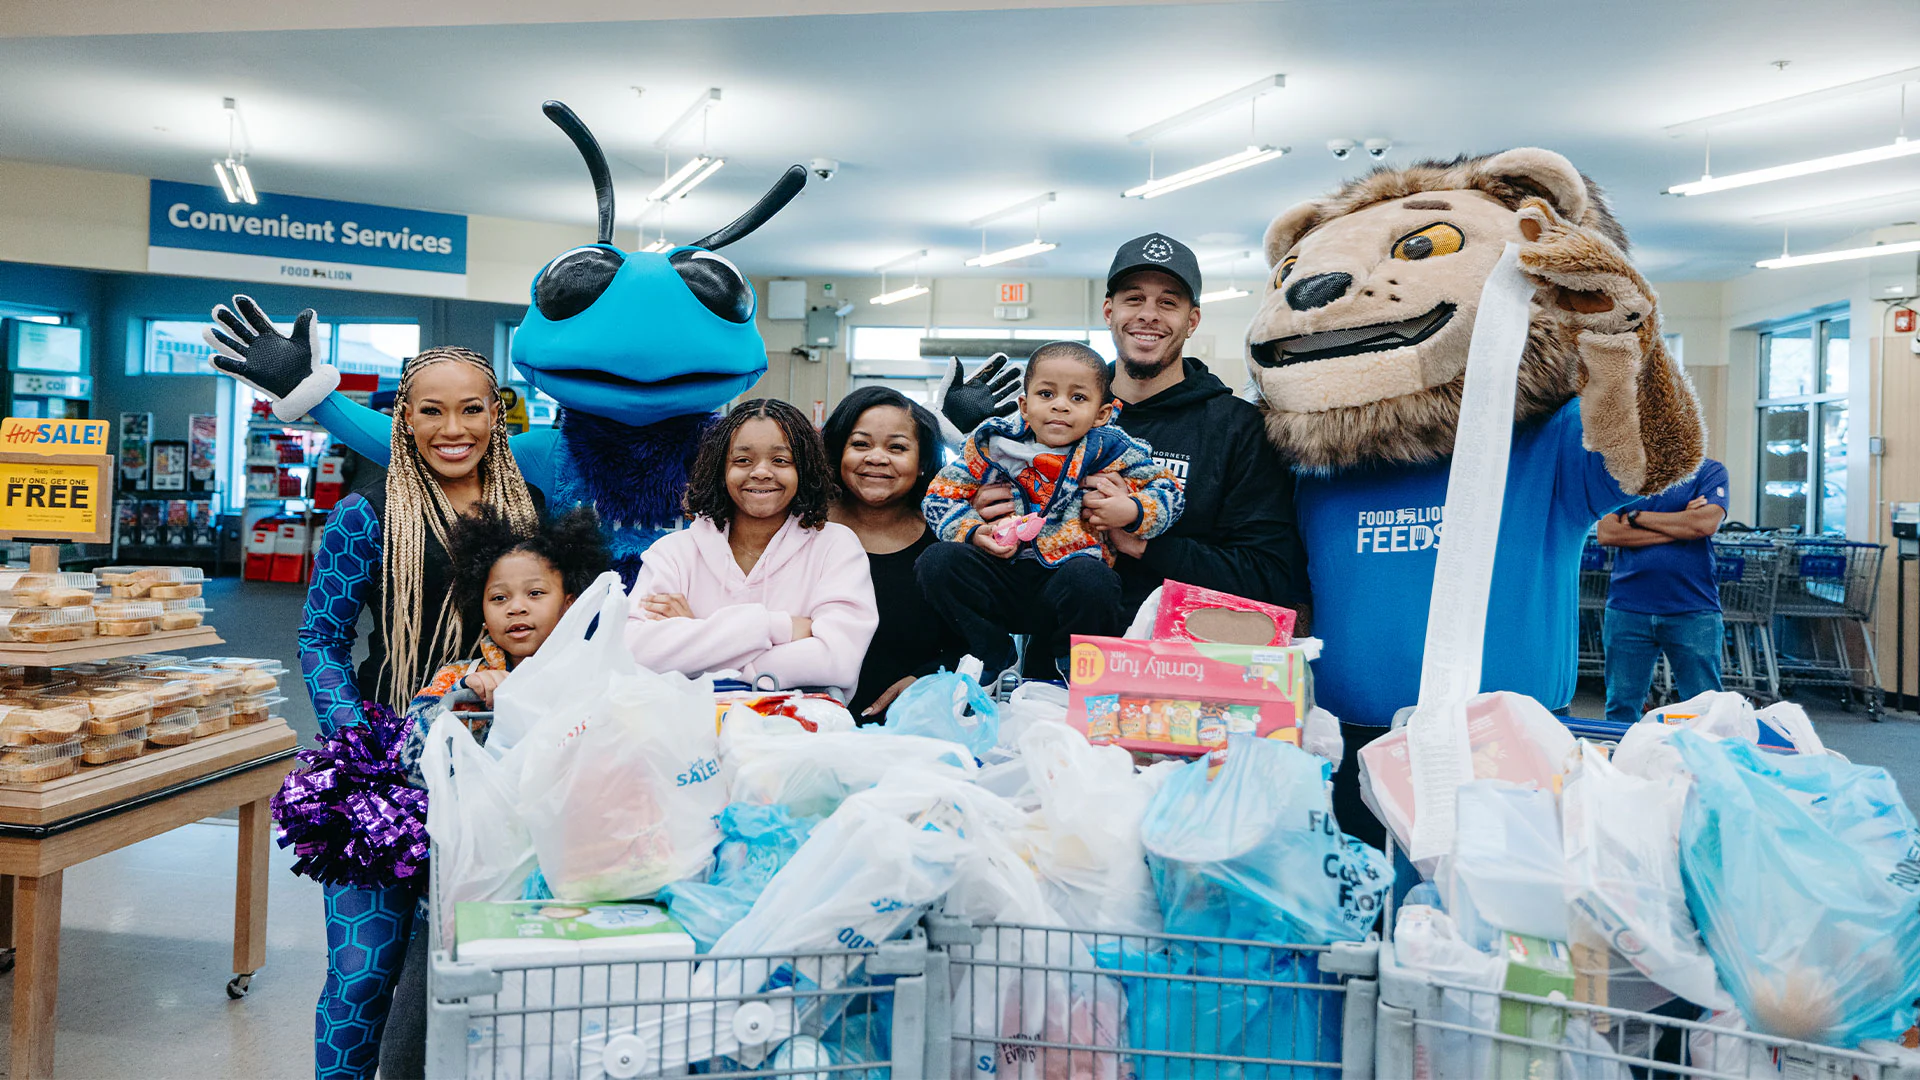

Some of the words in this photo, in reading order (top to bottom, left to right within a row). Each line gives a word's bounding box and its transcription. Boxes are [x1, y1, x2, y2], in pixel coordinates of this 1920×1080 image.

[168, 203, 335, 243] Convenient
[340, 221, 452, 255] Services
[280, 265, 310, 277] FOOD
[328, 268, 353, 281] LION
[1001, 283, 1025, 302] EXIT
[6, 423, 42, 444] Hot
[37, 423, 104, 445] SALE!
[1153, 450, 1191, 461] HORNETS
[6, 483, 89, 509] FREE
[1358, 511, 1395, 526] FOOD
[1356, 522, 1445, 554] FEEDS
[1076, 657, 1096, 678] 18
[1109, 657, 1140, 678] fun
[1143, 655, 1205, 682] family
[676, 758, 720, 787] SALE!
